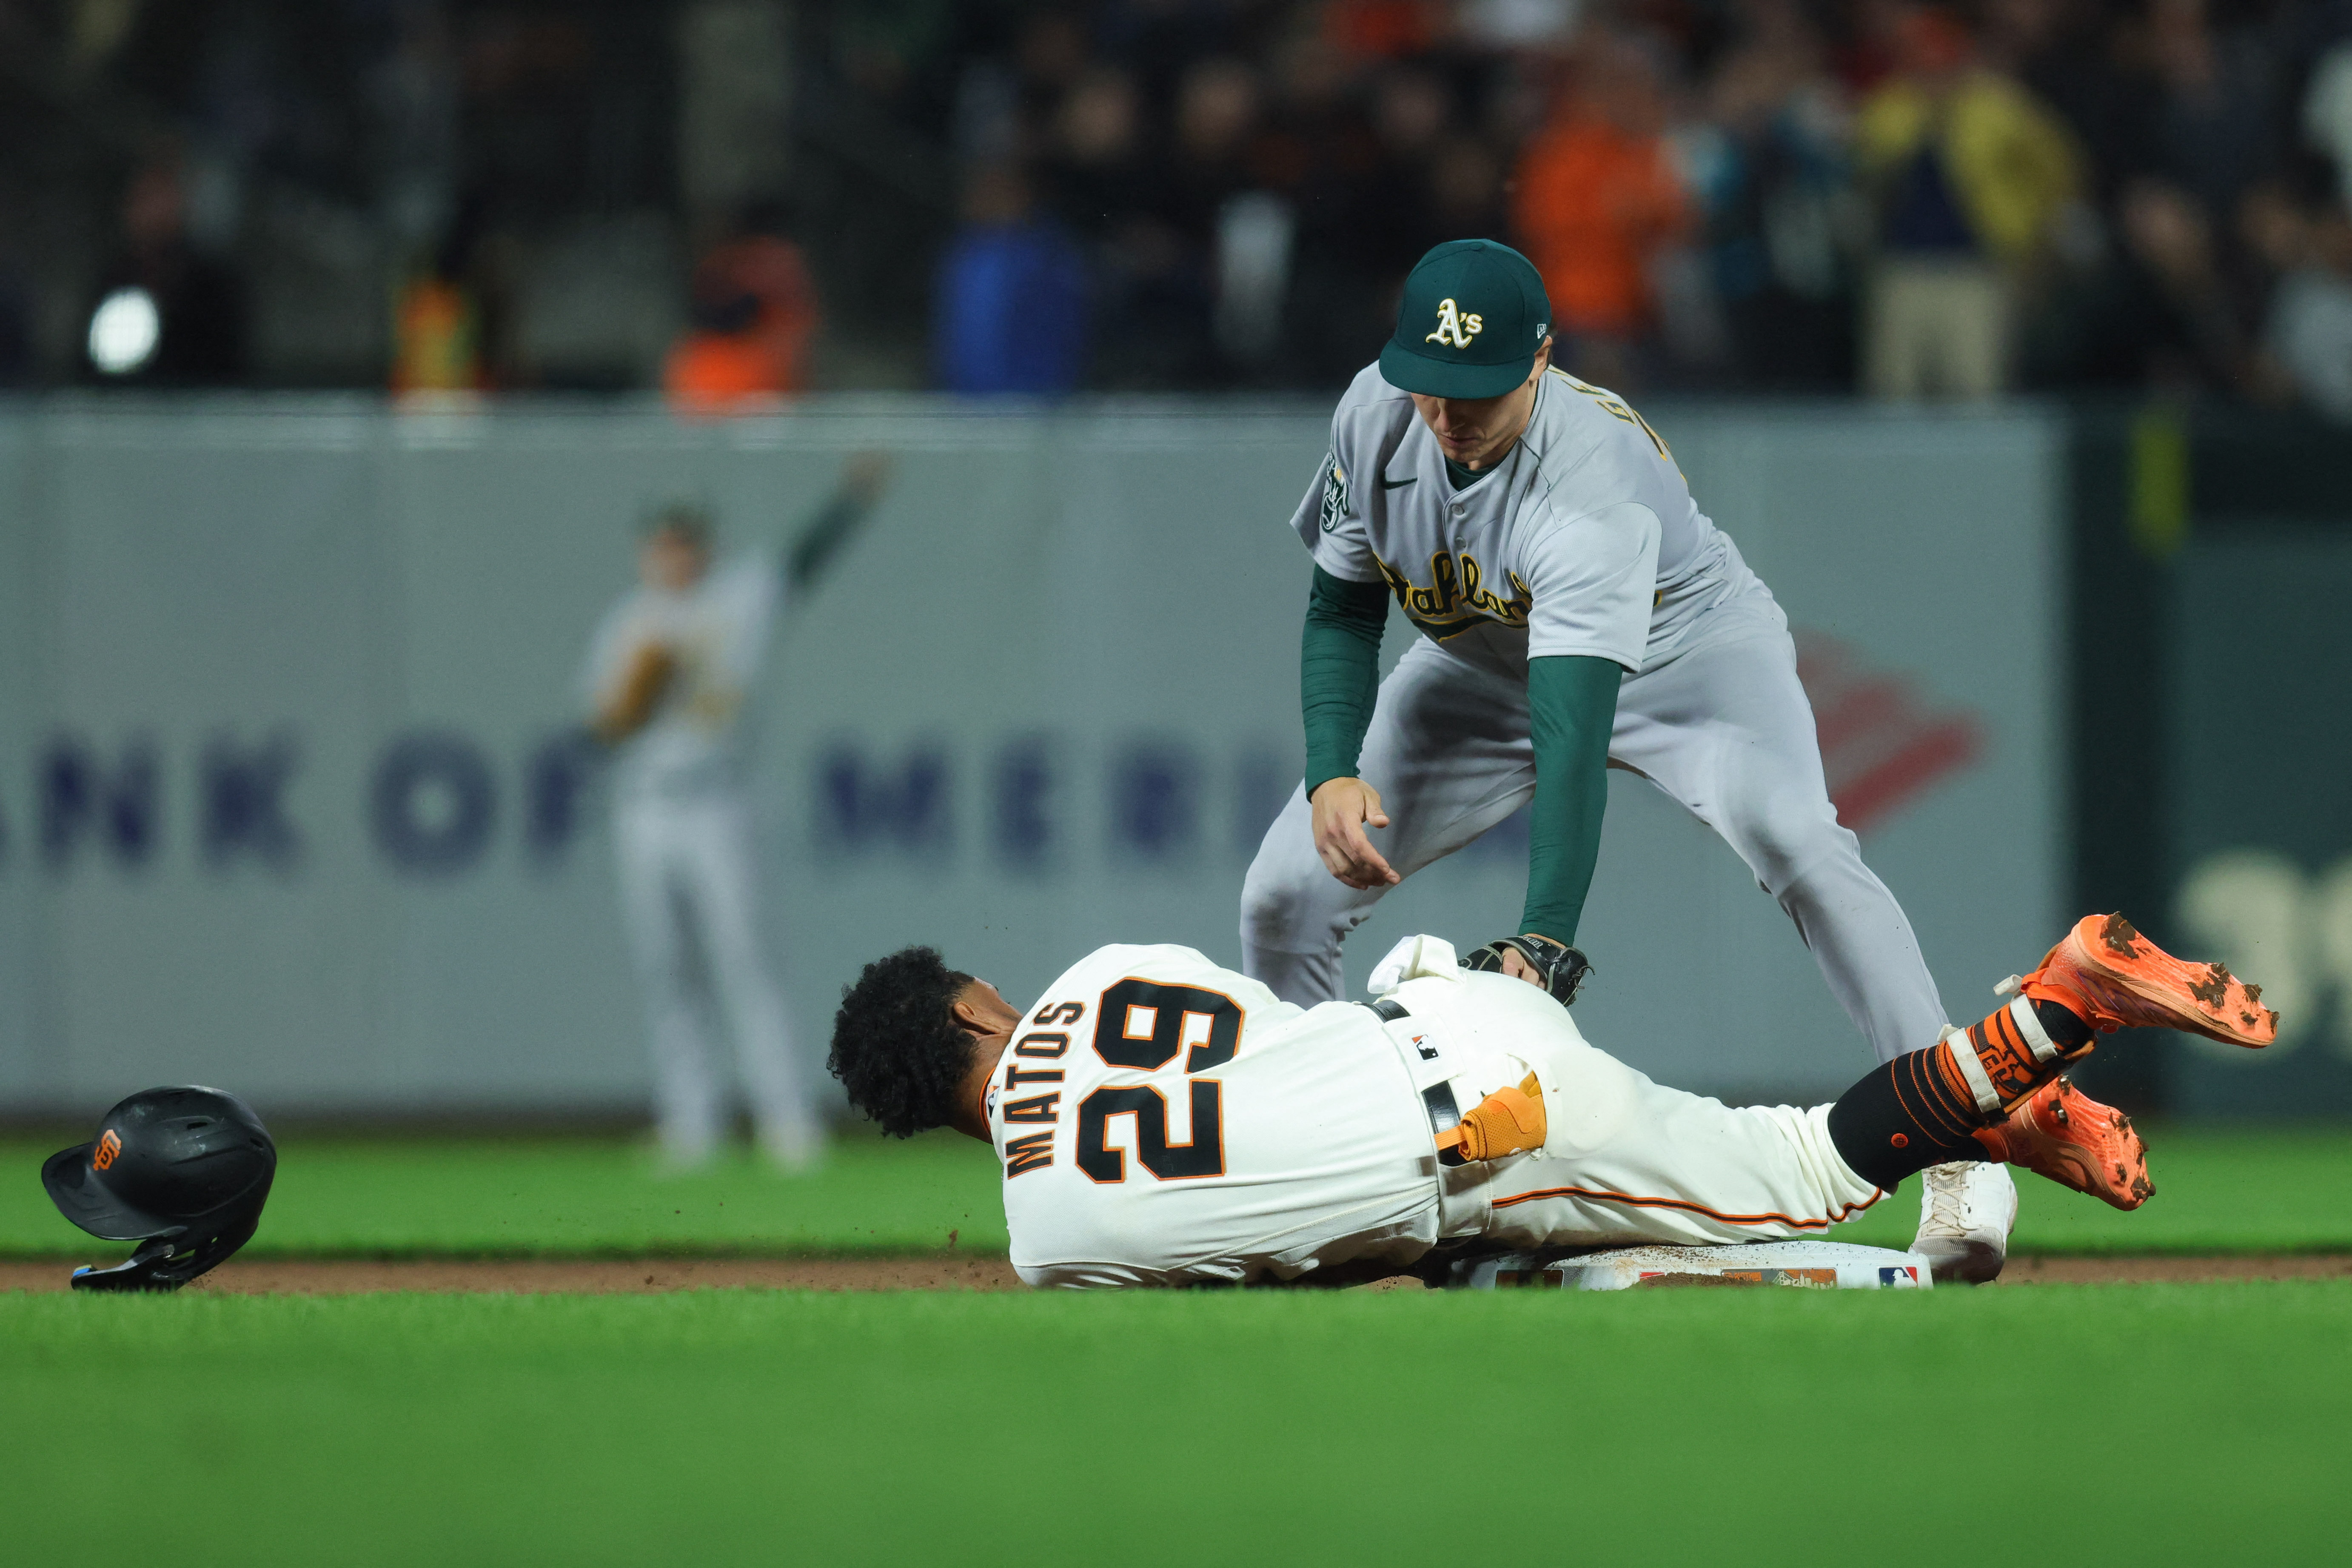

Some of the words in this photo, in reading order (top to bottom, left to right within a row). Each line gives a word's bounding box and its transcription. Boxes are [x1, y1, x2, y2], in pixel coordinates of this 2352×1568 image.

[1425, 298, 1483, 350] A's
[0, 723, 303, 876] NK
[1003, 1001, 1086, 1180] MATOS
[1075, 975, 1246, 1184] 29
